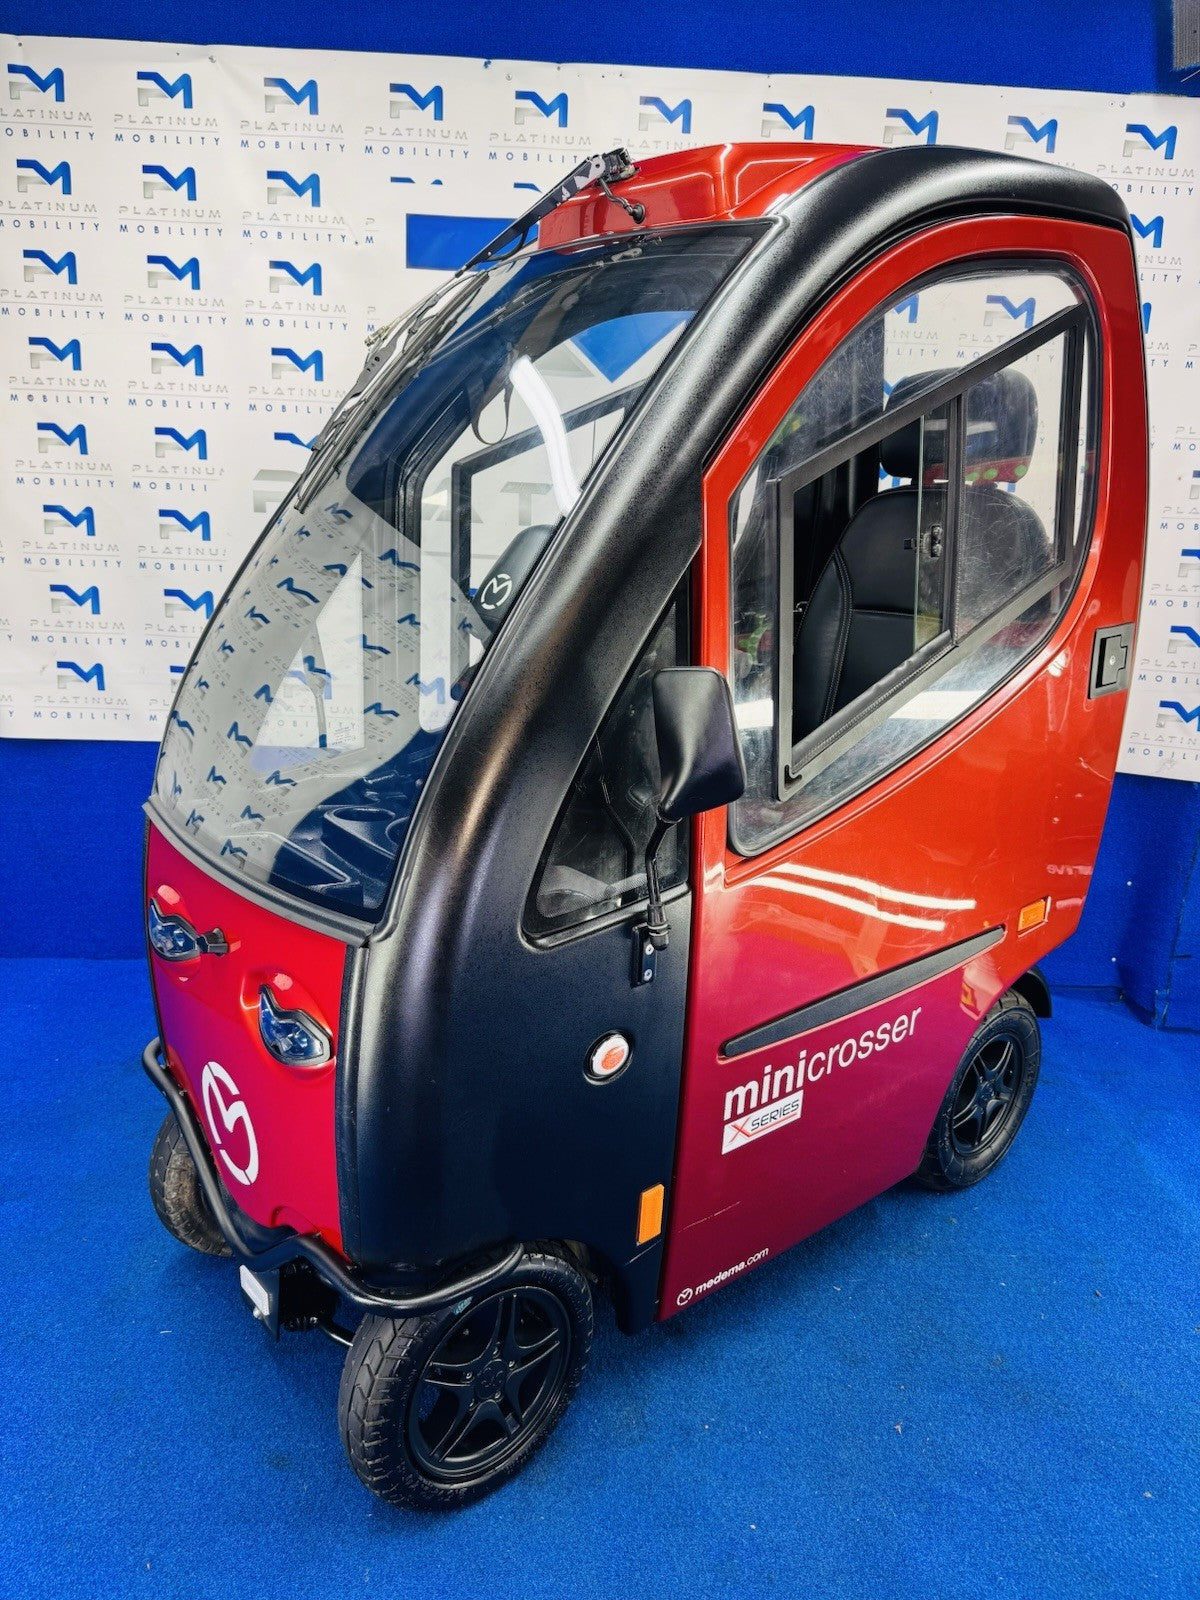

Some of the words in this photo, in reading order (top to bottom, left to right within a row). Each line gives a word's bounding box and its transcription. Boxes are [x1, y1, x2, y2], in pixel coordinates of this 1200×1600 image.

[0, 109, 92, 122] LATINUM
[114, 114, 218, 127] PLATINUM
[240, 121, 344, 134] PLATINUM
[364, 126, 468, 140] PLATINUM
[0, 128, 94, 140] OBILITY
[115, 134, 220, 146] MOBILITY
[489, 133, 592, 145] PLATINUM
[241, 139, 345, 152] MOBILITY
[364, 146, 469, 158] MOBILITY
[488, 152, 578, 163] MOBILIT
[1096, 164, 1194, 178] PLATINUM
[1111, 184, 1194, 196] OBILITY
[119, 206, 222, 219] PLATINUM
[242, 211, 345, 224] PLATINUM
[120, 224, 222, 236] MOBILITY
[243, 230, 346, 243] MOBILITY
[1, 289, 102, 301] PLATINUM
[124, 295, 224, 307] PLATINUM
[245, 301, 347, 313] PLATINUM
[1, 307, 104, 320] MOBILITY
[125, 313, 227, 325] MOBILITY
[246, 318, 348, 331] MOBILITY
[9, 376, 107, 388] PLATINUM
[129, 381, 229, 393] PLATINUM
[10, 393, 109, 404] MOBILITY
[129, 399, 230, 410] MOBILITY
[16, 460, 112, 472] PLATINUM
[132, 464, 225, 476] PLATINU
[16, 477, 115, 488] MOBILITY
[23, 541, 120, 552] PLATINUM
[138, 546, 227, 556] PLATINU
[24, 558, 122, 568] MOBILITY
[139, 562, 223, 572] MOBILIT
[30, 620, 125, 630] PLATINUM
[31, 636, 127, 646] MOBILITY
[34, 695, 128, 706] PLATINUM
[34, 711, 130, 720] MOBILITY
[723, 1006, 922, 1121] minicrosser
[695, 1247, 769, 1296] medema.com
